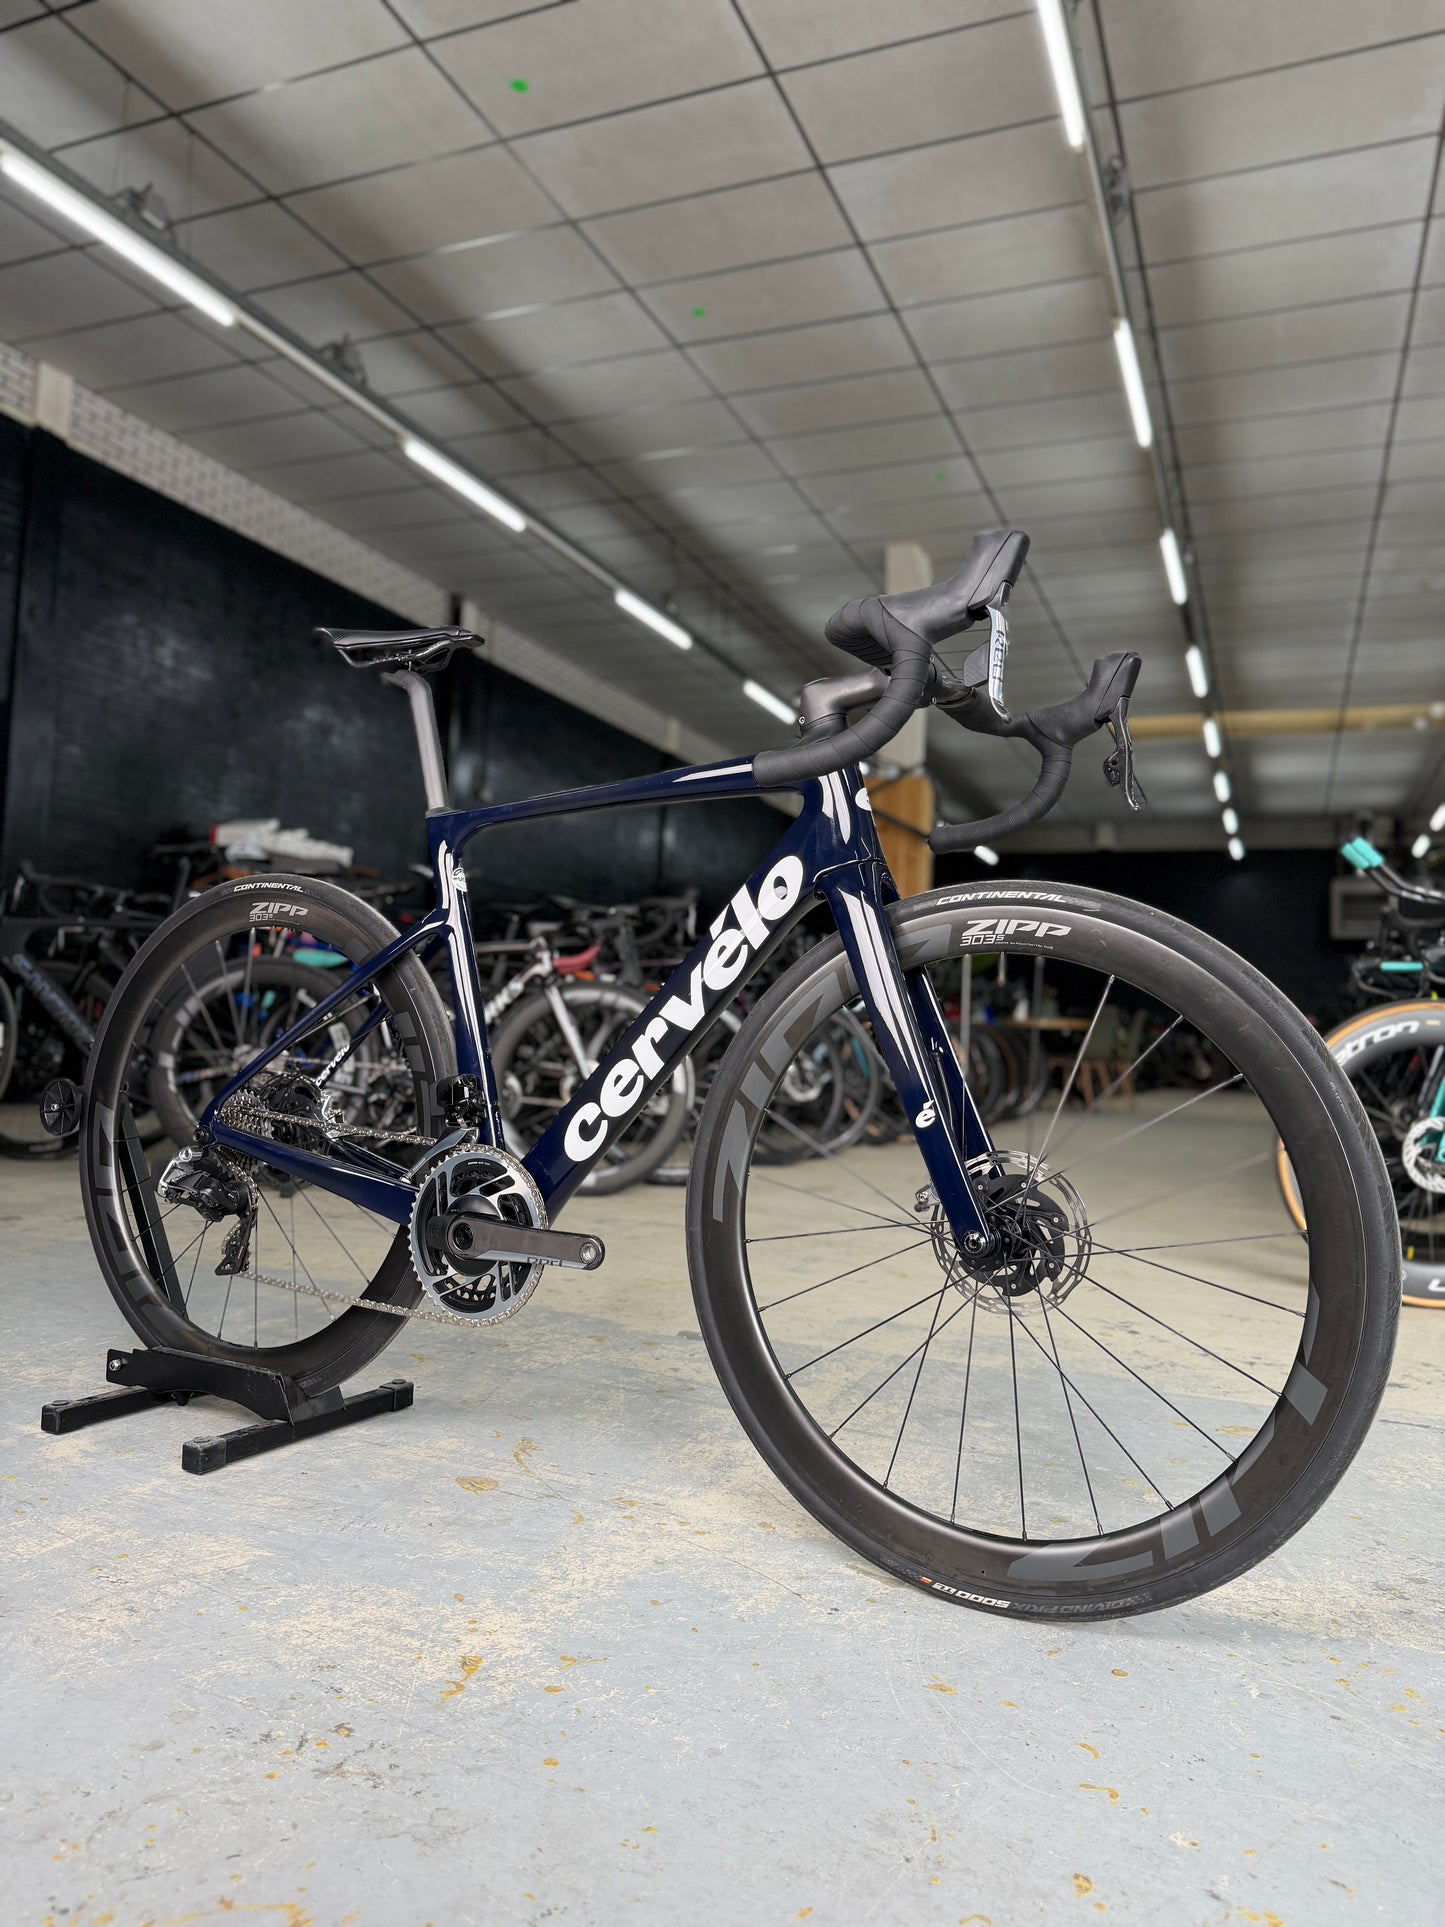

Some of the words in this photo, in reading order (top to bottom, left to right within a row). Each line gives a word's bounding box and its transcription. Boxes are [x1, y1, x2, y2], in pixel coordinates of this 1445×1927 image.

[233, 882, 304, 893] CONTINENTAL
[936, 890, 1067, 906] CONTINENTAL
[249, 901, 309, 917] ZIPP
[961, 918, 1072, 938] ZIPP
[563, 855, 804, 1162] cervélo
[915, 1099, 936, 1129] é
[955, 1590, 1011, 1609] 5000
